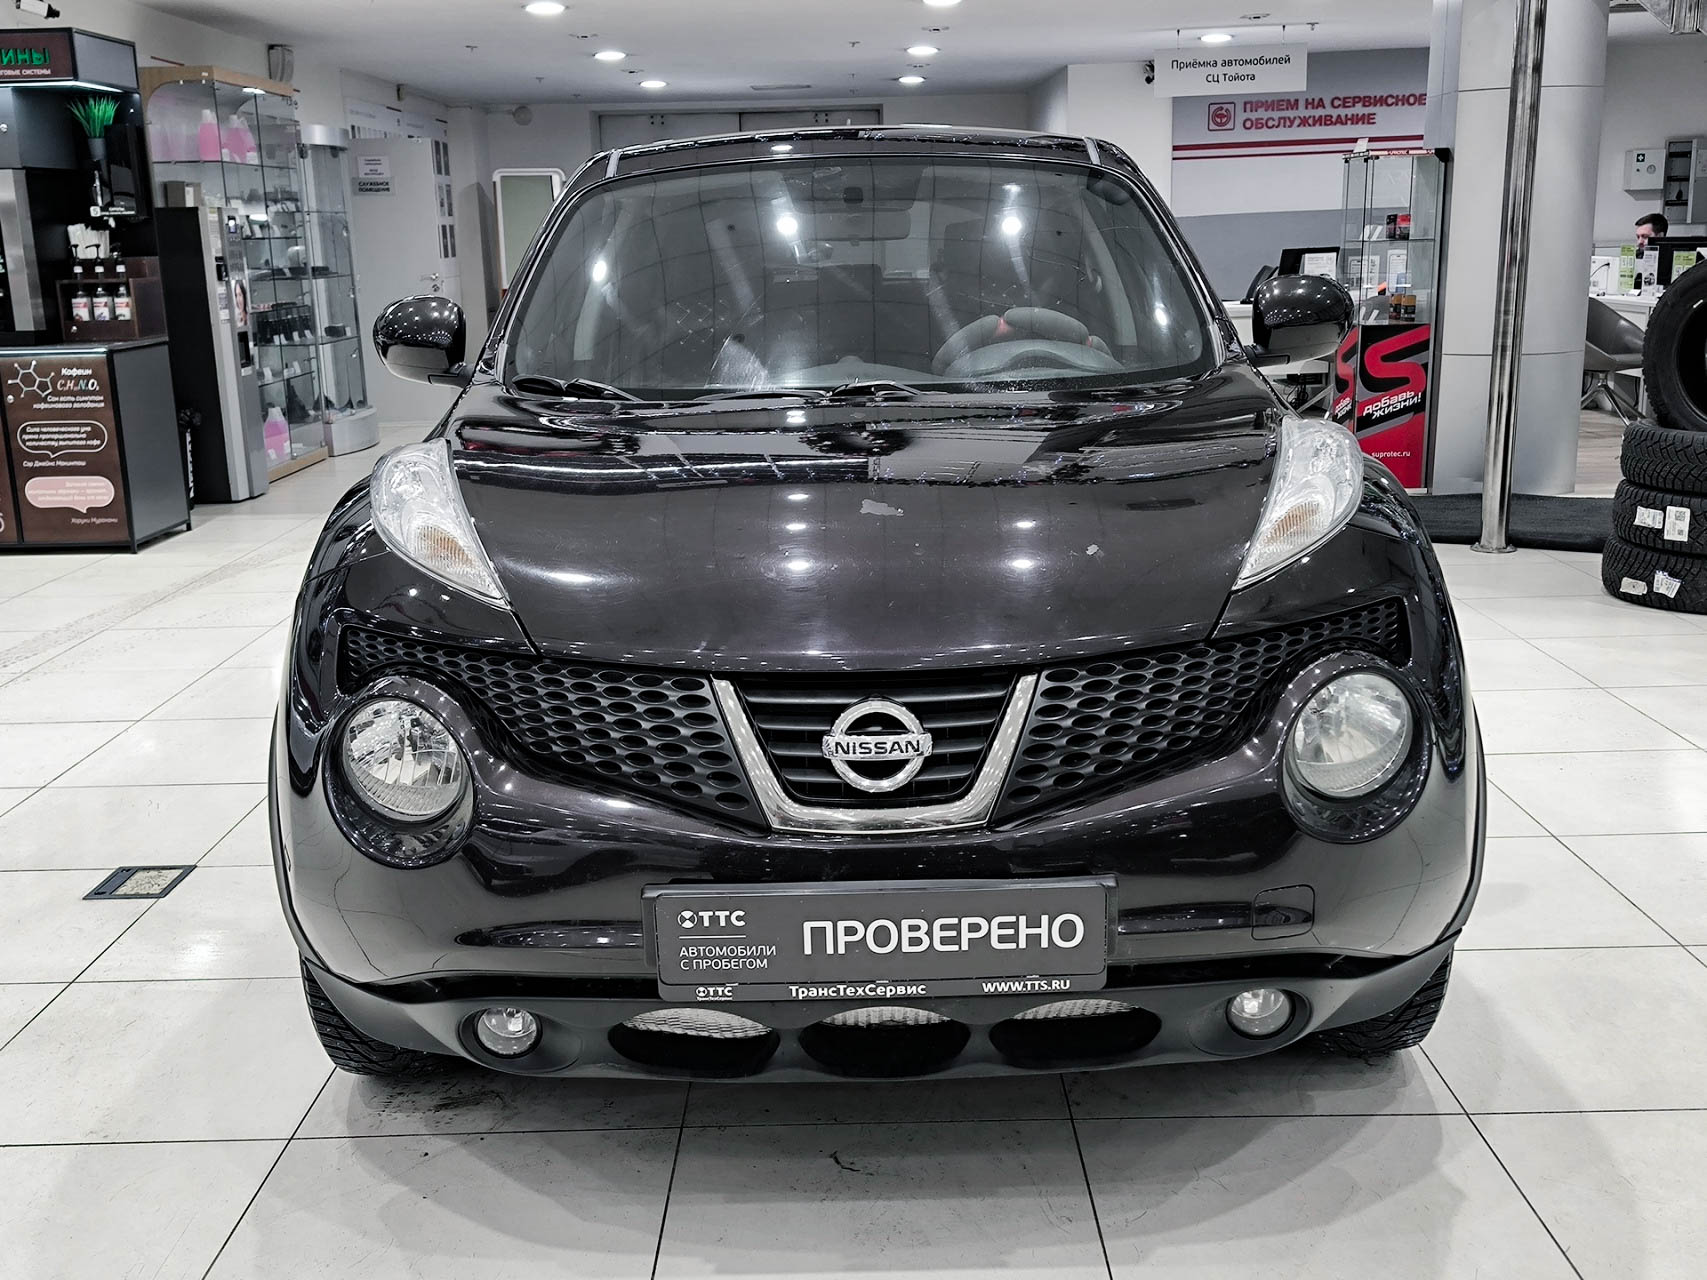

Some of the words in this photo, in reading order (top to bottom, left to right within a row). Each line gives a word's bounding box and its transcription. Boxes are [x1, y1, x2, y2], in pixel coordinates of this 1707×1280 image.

[0, 47, 50, 66] ИНЫ
[1171, 59, 1218, 71] Приёмка
[1220, 54, 1291, 67] автомобилей
[1205, 74, 1220, 83] СЦ
[1222, 73, 1256, 82] Тойота
[1243, 98, 1299, 113] ПРИЕМ
[1304, 97, 1326, 110] НА
[1331, 93, 1427, 109] СЕРВИСНОЕ
[1242, 112, 1377, 130] ОБСЛУЖИВАНИЕ
[61, 368, 92, 377] Кофеин
[1363, 391, 1415, 417] добавь
[1372, 392, 1422, 419] жизни!
[1371, 451, 1411, 459] suprotec.ru
[834, 740, 920, 755] NISSAN
[699, 910, 746, 927] ТТС
[803, 913, 1084, 955] ПРОВЕРЕНО
[680, 945, 777, 957] АВТОМОБИЛИ
[680, 960, 690, 970] С
[693, 958, 768, 970] ПРОБЕГОМ
[707, 987, 733, 996] ТТС
[789, 983, 927, 999] ТрансТехСервис
[982, 979, 1071, 993] WWW.TTS.RU
